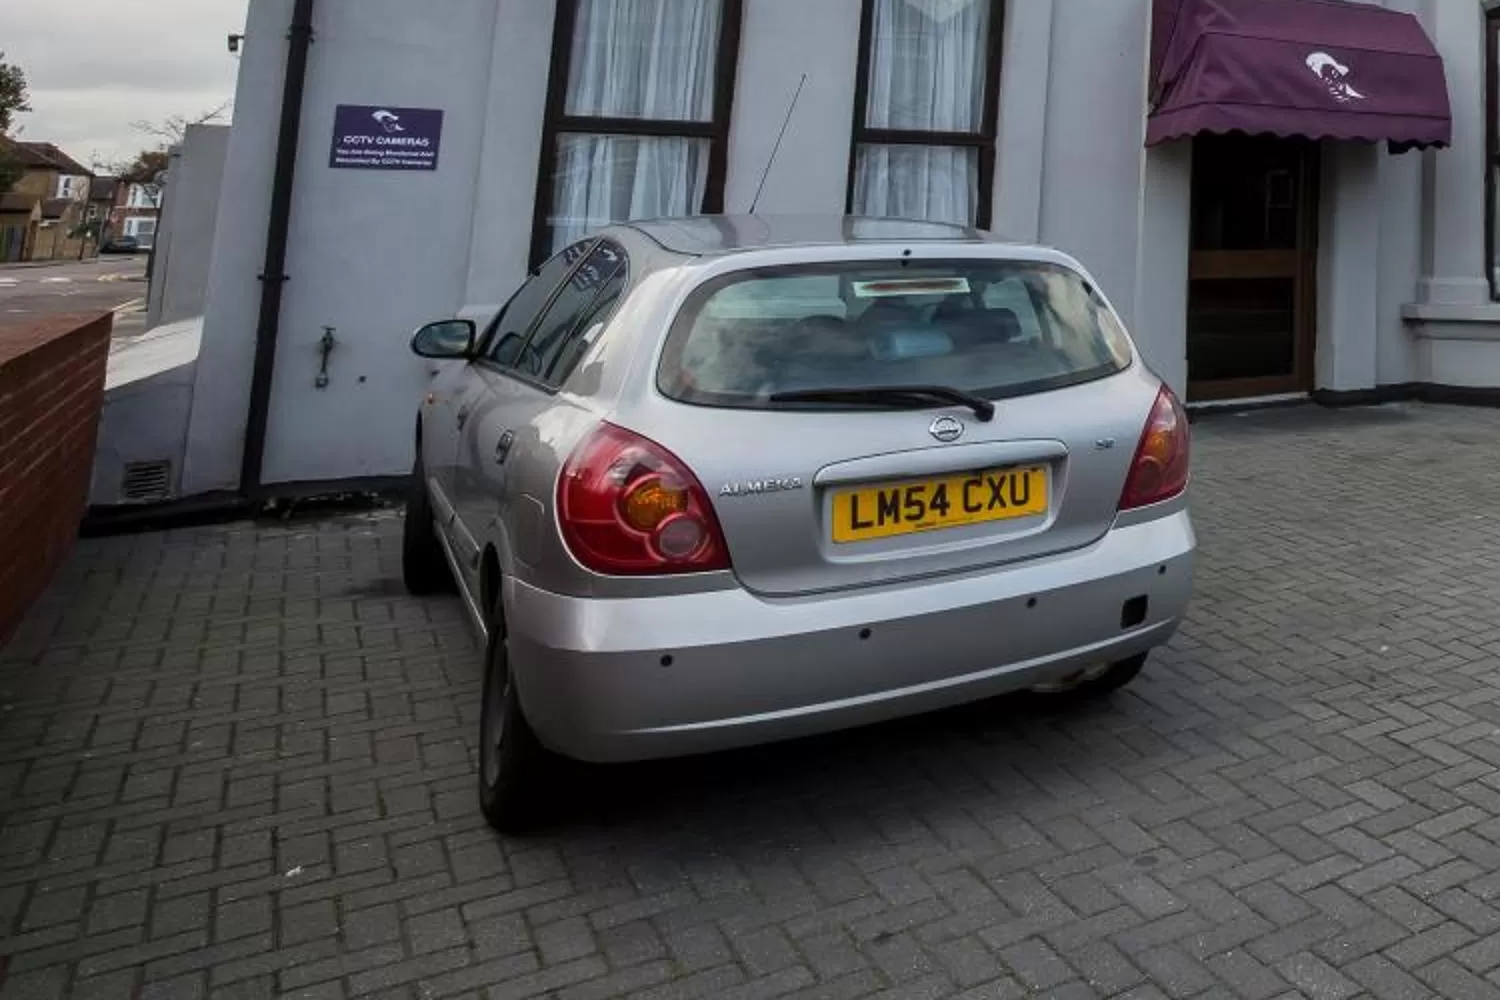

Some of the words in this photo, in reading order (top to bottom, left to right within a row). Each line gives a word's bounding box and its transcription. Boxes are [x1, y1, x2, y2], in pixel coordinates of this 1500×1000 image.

[343, 135, 374, 145] CCTV
[376, 136, 430, 147] CAMERAS
[851, 483, 951, 530] LM54
[962, 472, 1030, 513] CXU
